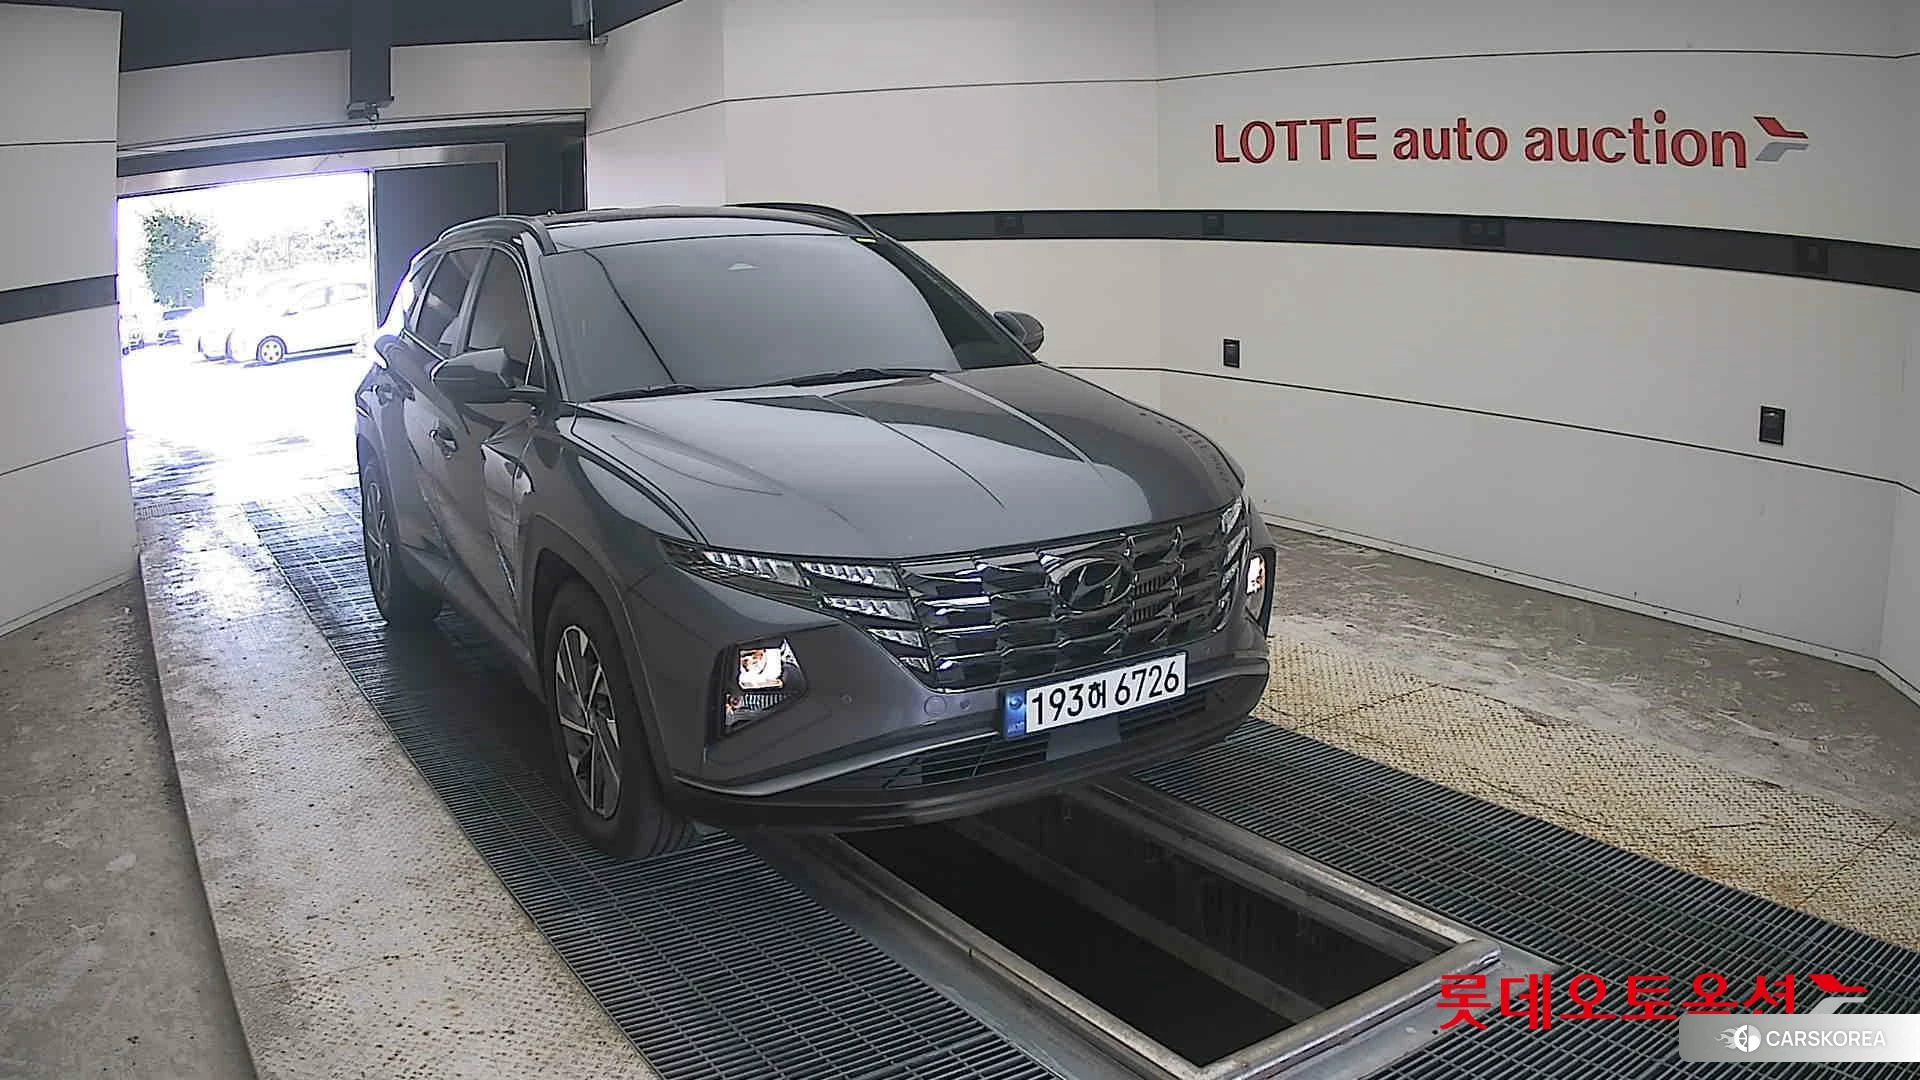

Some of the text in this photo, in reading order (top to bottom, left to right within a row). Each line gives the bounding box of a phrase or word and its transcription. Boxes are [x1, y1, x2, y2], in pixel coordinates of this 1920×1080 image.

[1215, 111, 1747, 168] LOTTE auto auction
[1032, 661, 1180, 725] 193허 6726
